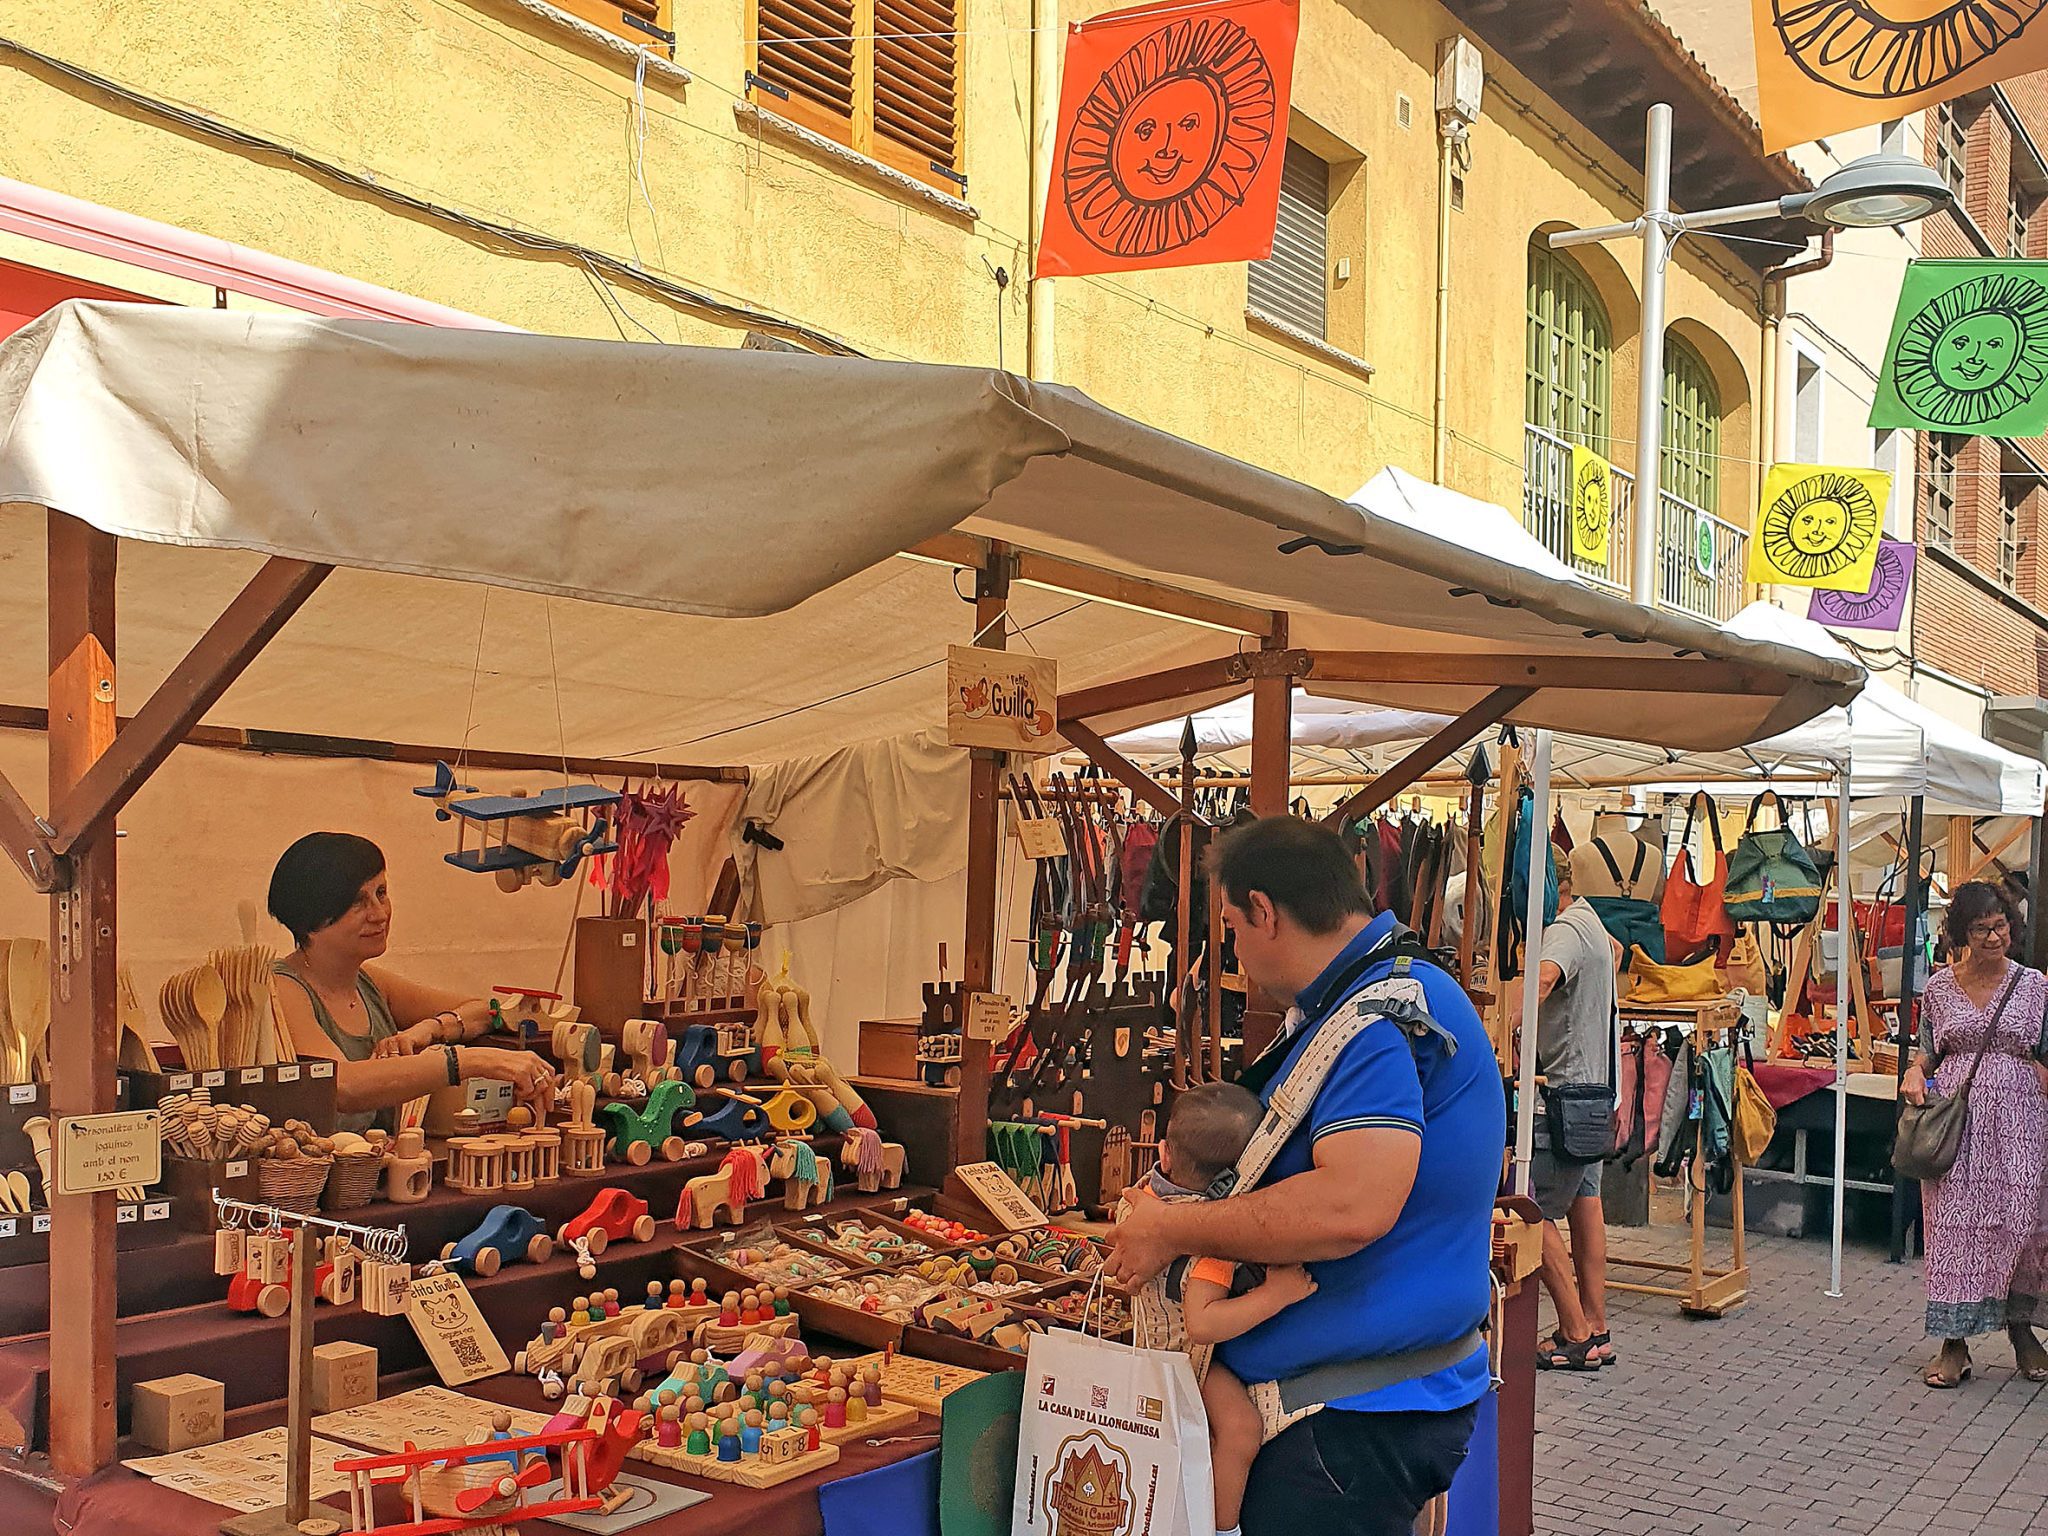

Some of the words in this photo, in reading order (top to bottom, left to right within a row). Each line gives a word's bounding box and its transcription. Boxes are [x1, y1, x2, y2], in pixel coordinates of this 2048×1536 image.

[991, 682, 1035, 720] Guilla
[82, 1157, 104, 1168] amb
[107, 1156, 116, 1166] el
[119, 1155, 140, 1164] nom
[120, 1210, 135, 1219] 3€
[410, 1283, 434, 1299] etita
[434, 1278, 461, 1293] Guilla
[1038, 1399, 1049, 1412] LA
[1050, 1404, 1072, 1418] CASA
[1074, 1409, 1085, 1421] DE
[1086, 1411, 1097, 1424] LA
[1098, 1414, 1161, 1439] LLONGANISSA
